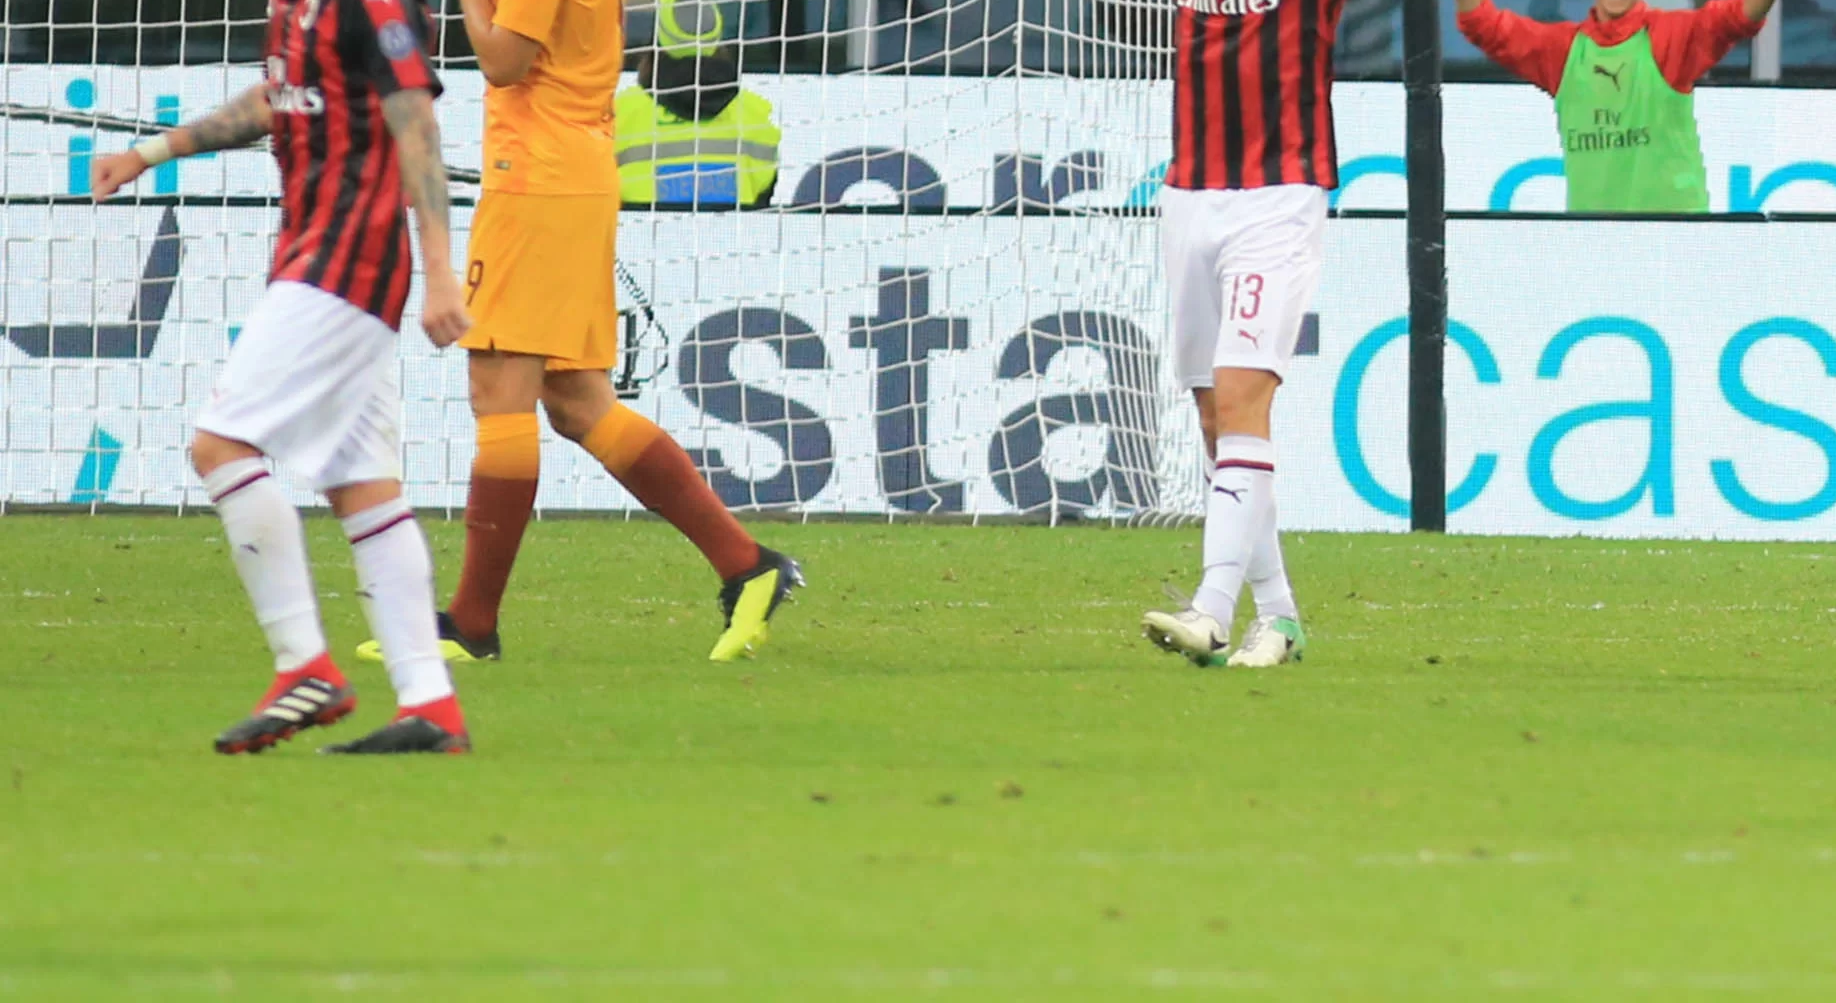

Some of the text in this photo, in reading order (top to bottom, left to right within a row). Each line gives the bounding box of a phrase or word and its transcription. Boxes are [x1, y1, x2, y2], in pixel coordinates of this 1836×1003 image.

[1593, 108, 1622, 126] Fly
[1567, 126, 1651, 153] Emirates
[466, 259, 485, 309] 9
[1229, 272, 1265, 322] 13
